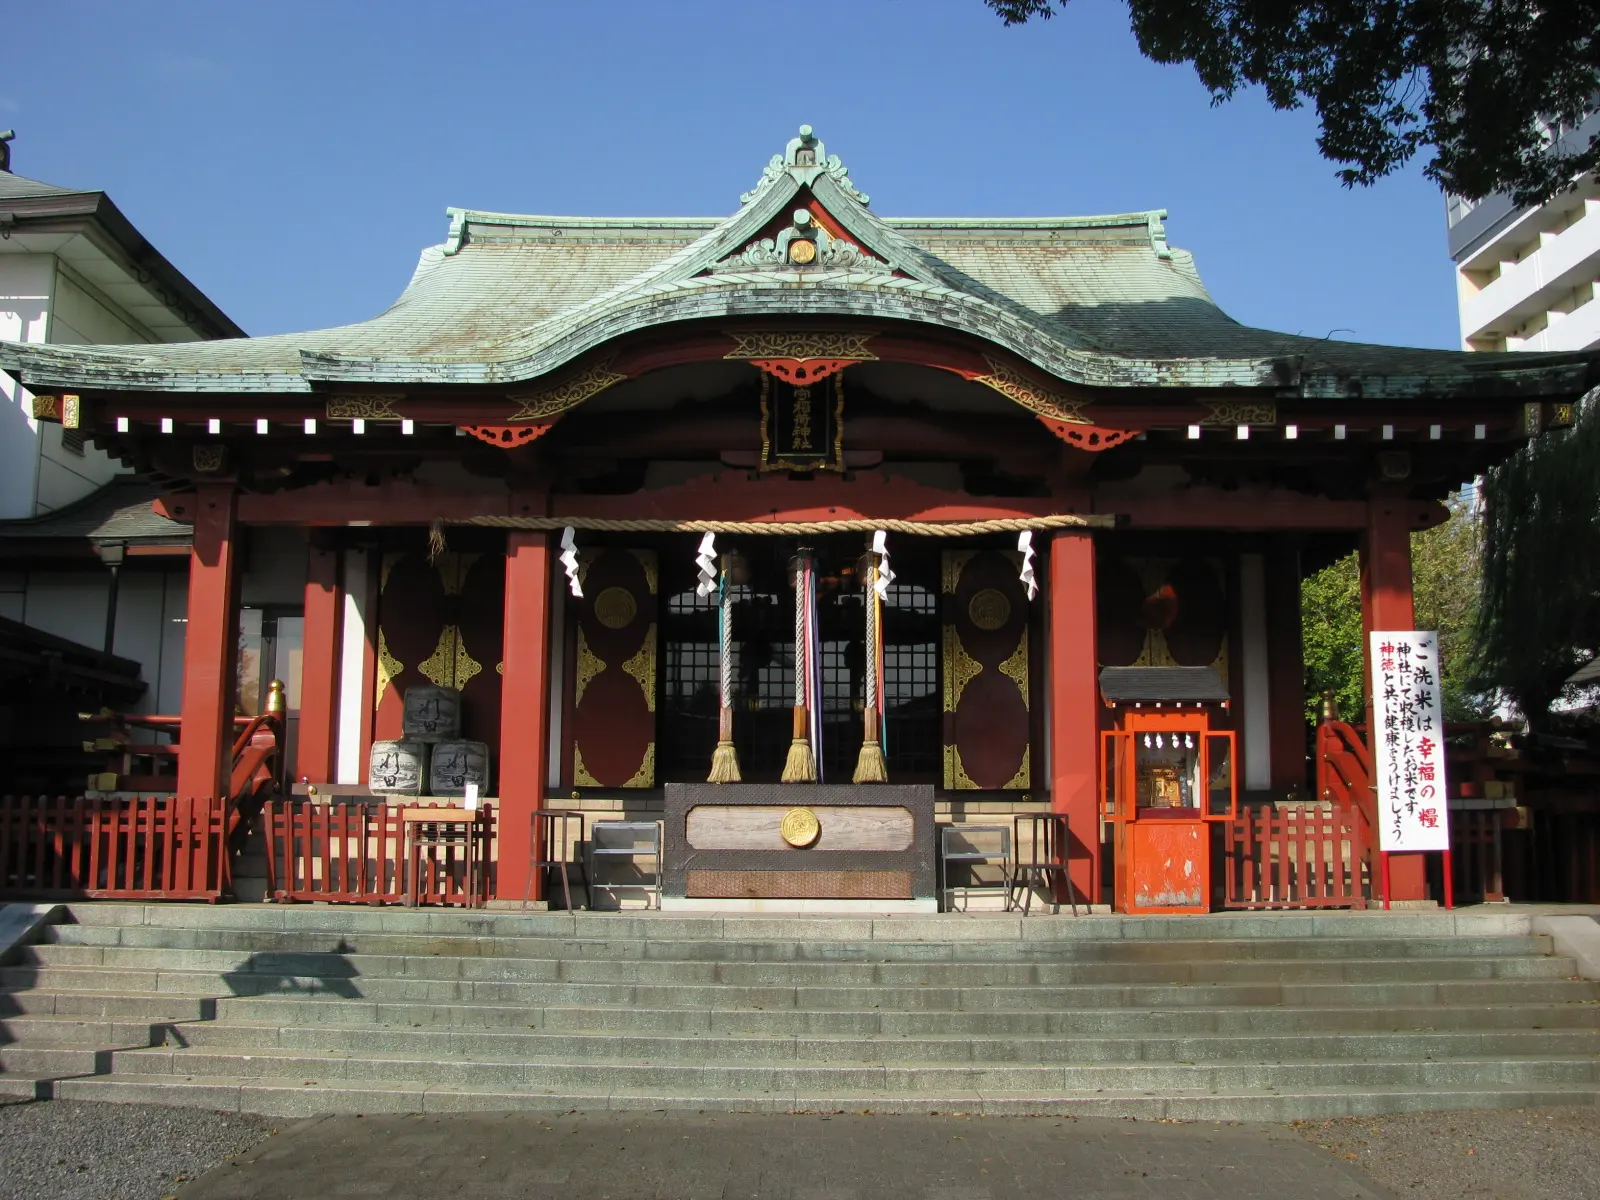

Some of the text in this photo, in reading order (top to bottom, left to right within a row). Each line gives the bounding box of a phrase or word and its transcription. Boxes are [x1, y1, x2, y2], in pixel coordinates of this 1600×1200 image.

[792, 384, 813, 450] 守稲荷神社
